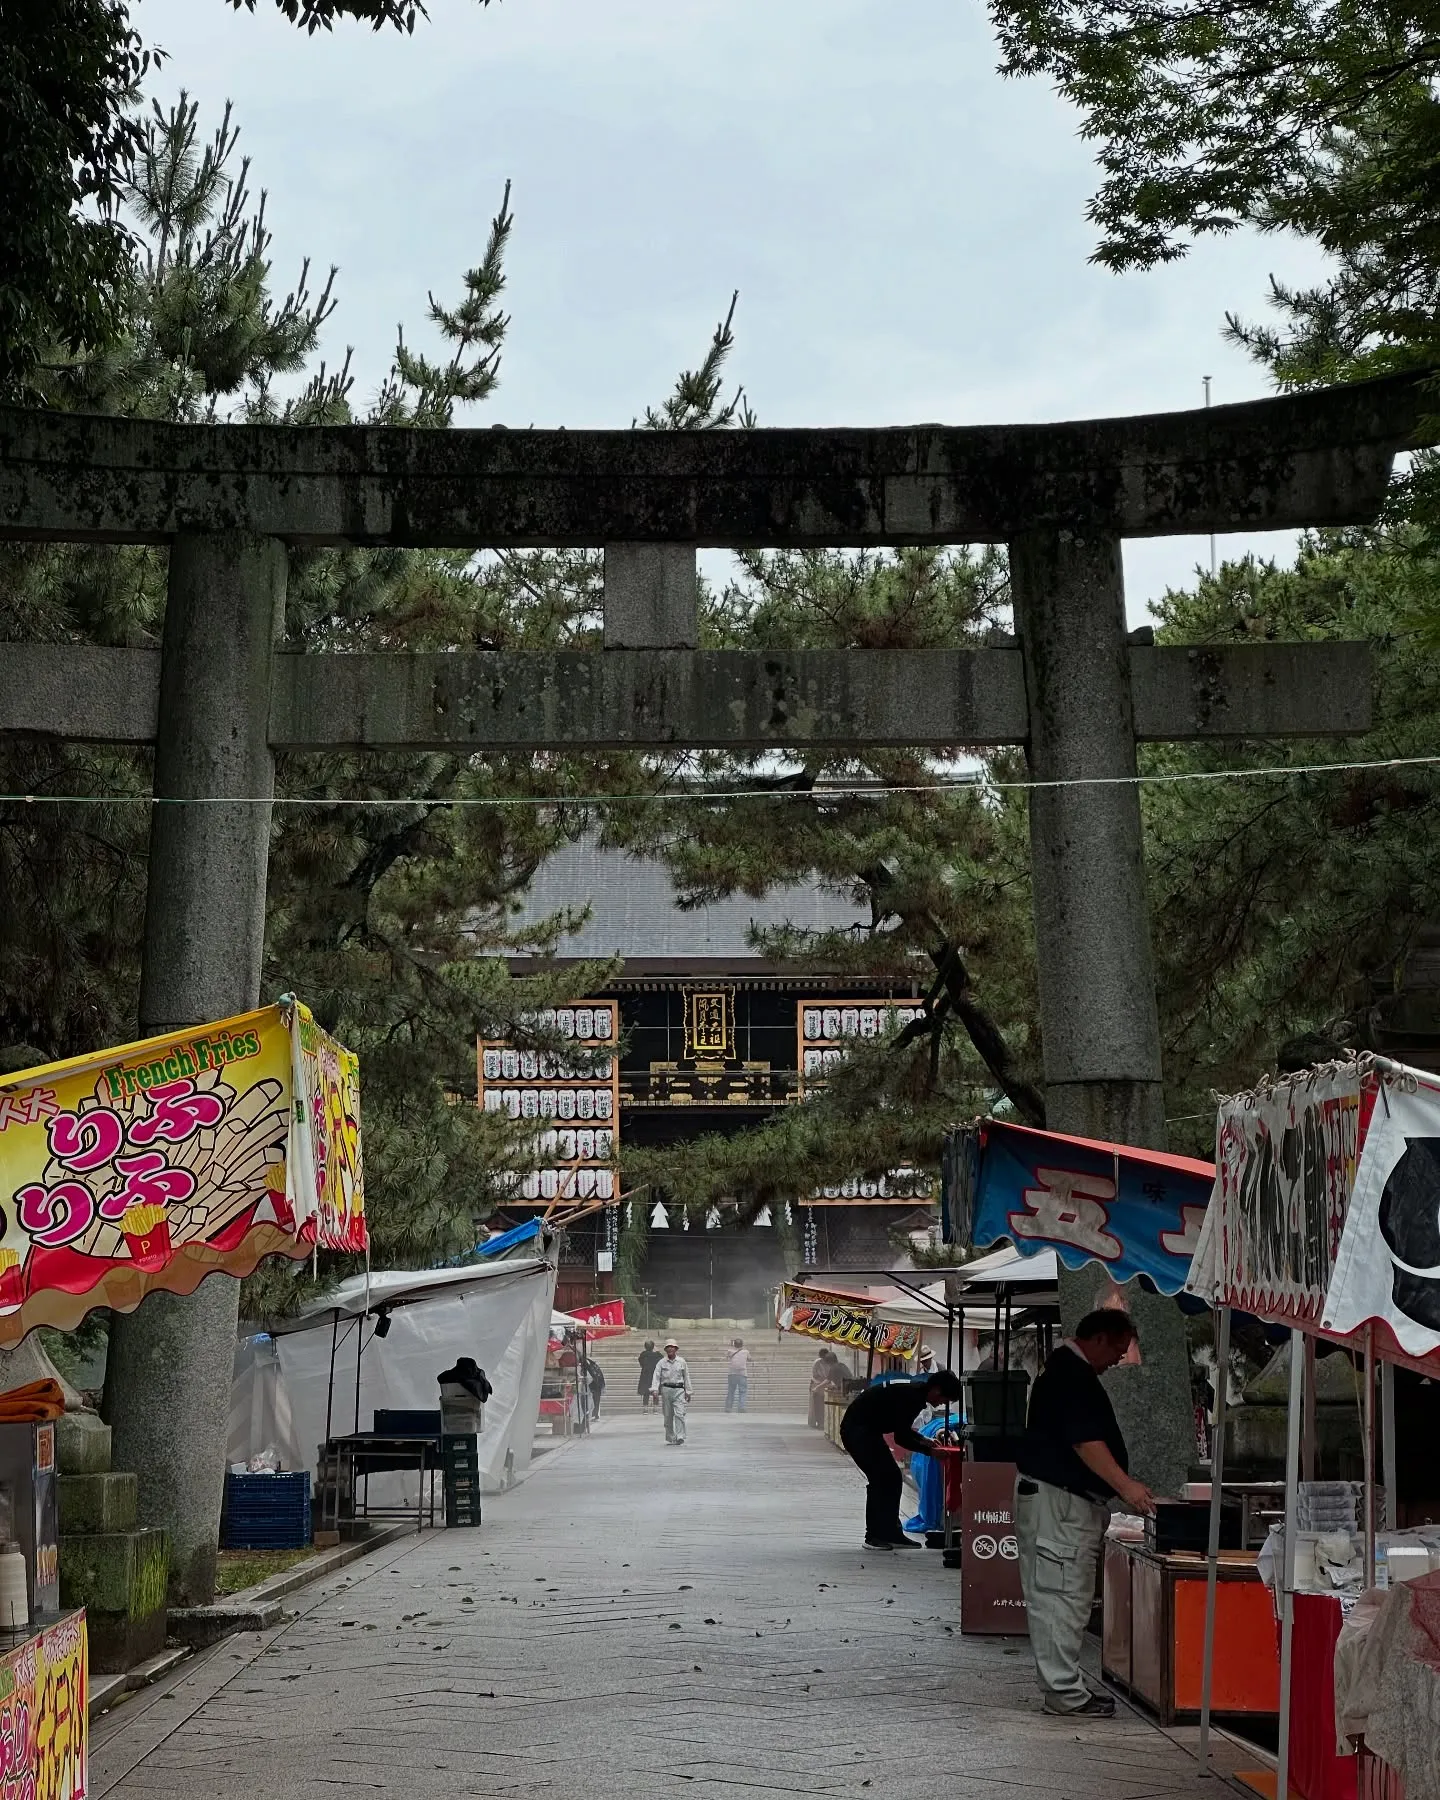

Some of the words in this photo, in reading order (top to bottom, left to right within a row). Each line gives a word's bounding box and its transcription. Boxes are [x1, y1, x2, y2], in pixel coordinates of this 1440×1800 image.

[102, 1047, 195, 1099] French
[192, 1029, 260, 1069] Fries
[973, 1510, 1014, 1524] 車輛進
